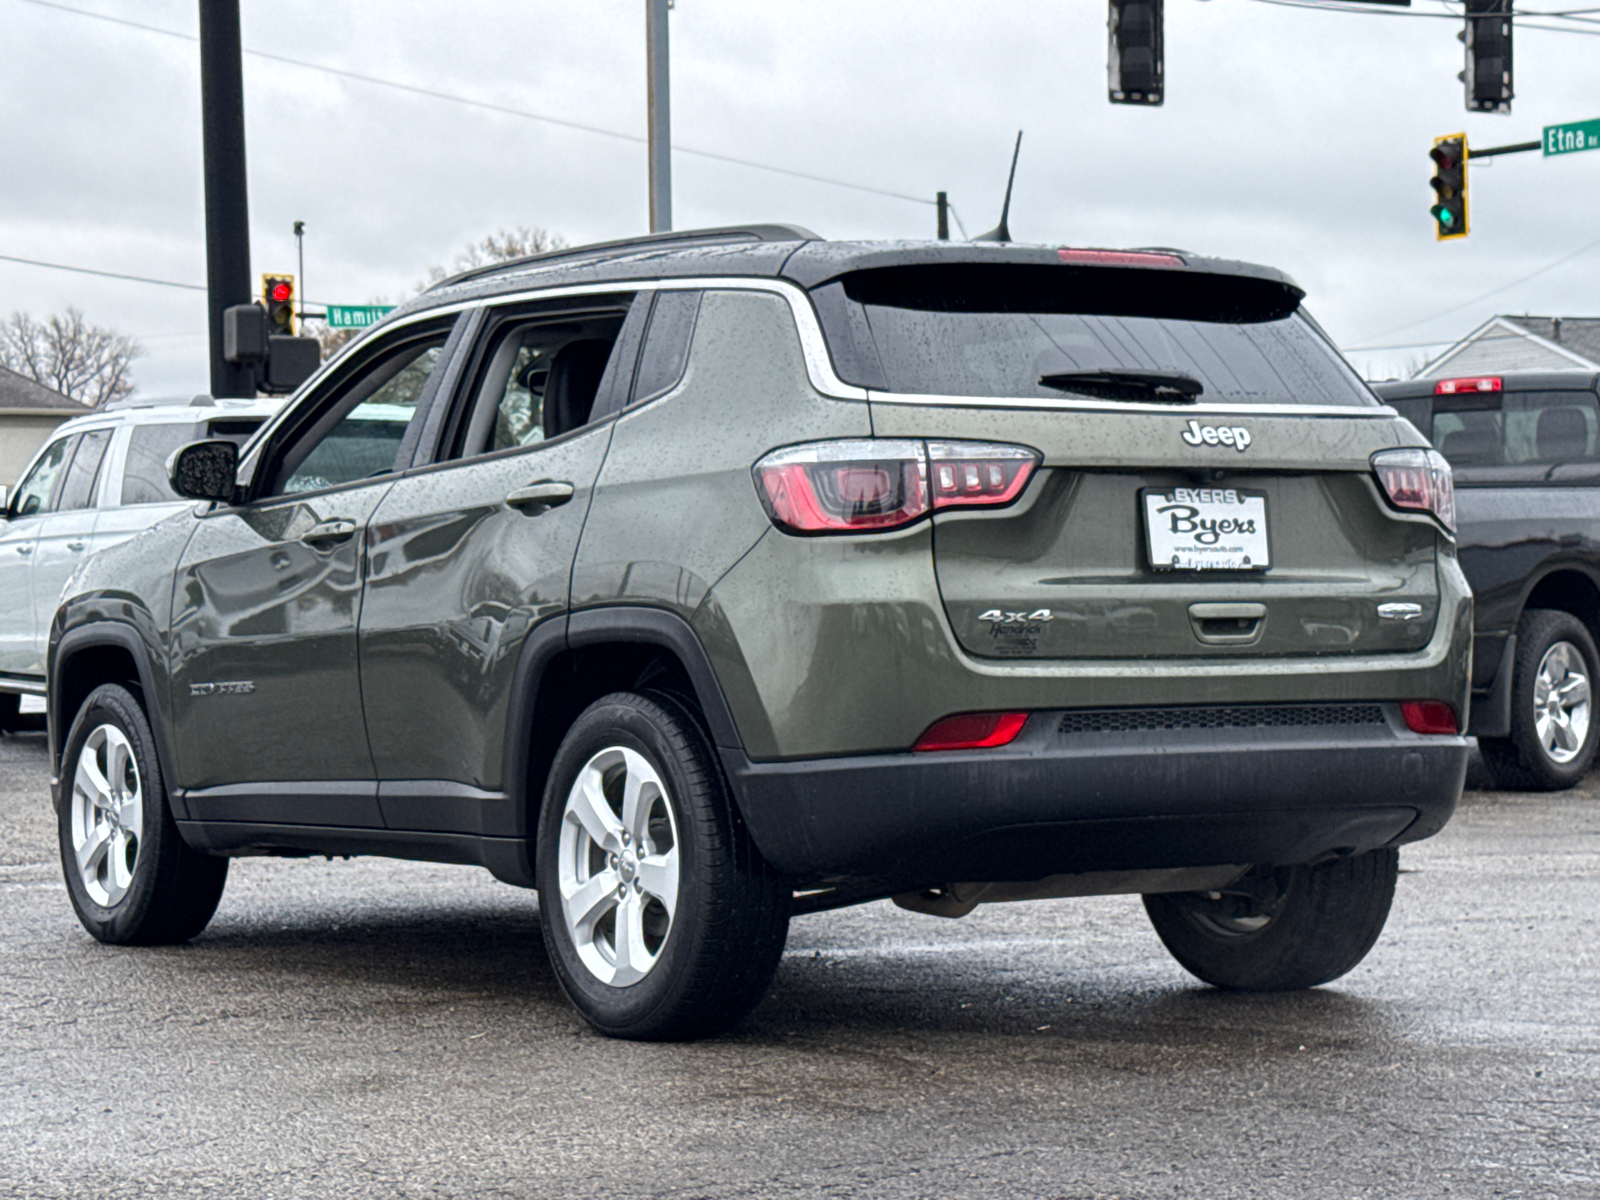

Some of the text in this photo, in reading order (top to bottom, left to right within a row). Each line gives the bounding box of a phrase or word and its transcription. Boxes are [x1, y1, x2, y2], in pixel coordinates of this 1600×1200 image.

[1548, 128, 1585, 153] Etna
[1182, 420, 1251, 451] Jeep
[1174, 487, 1238, 504] BYERS
[1155, 504, 1257, 545] Byers
[977, 608, 1055, 623] 4x4
